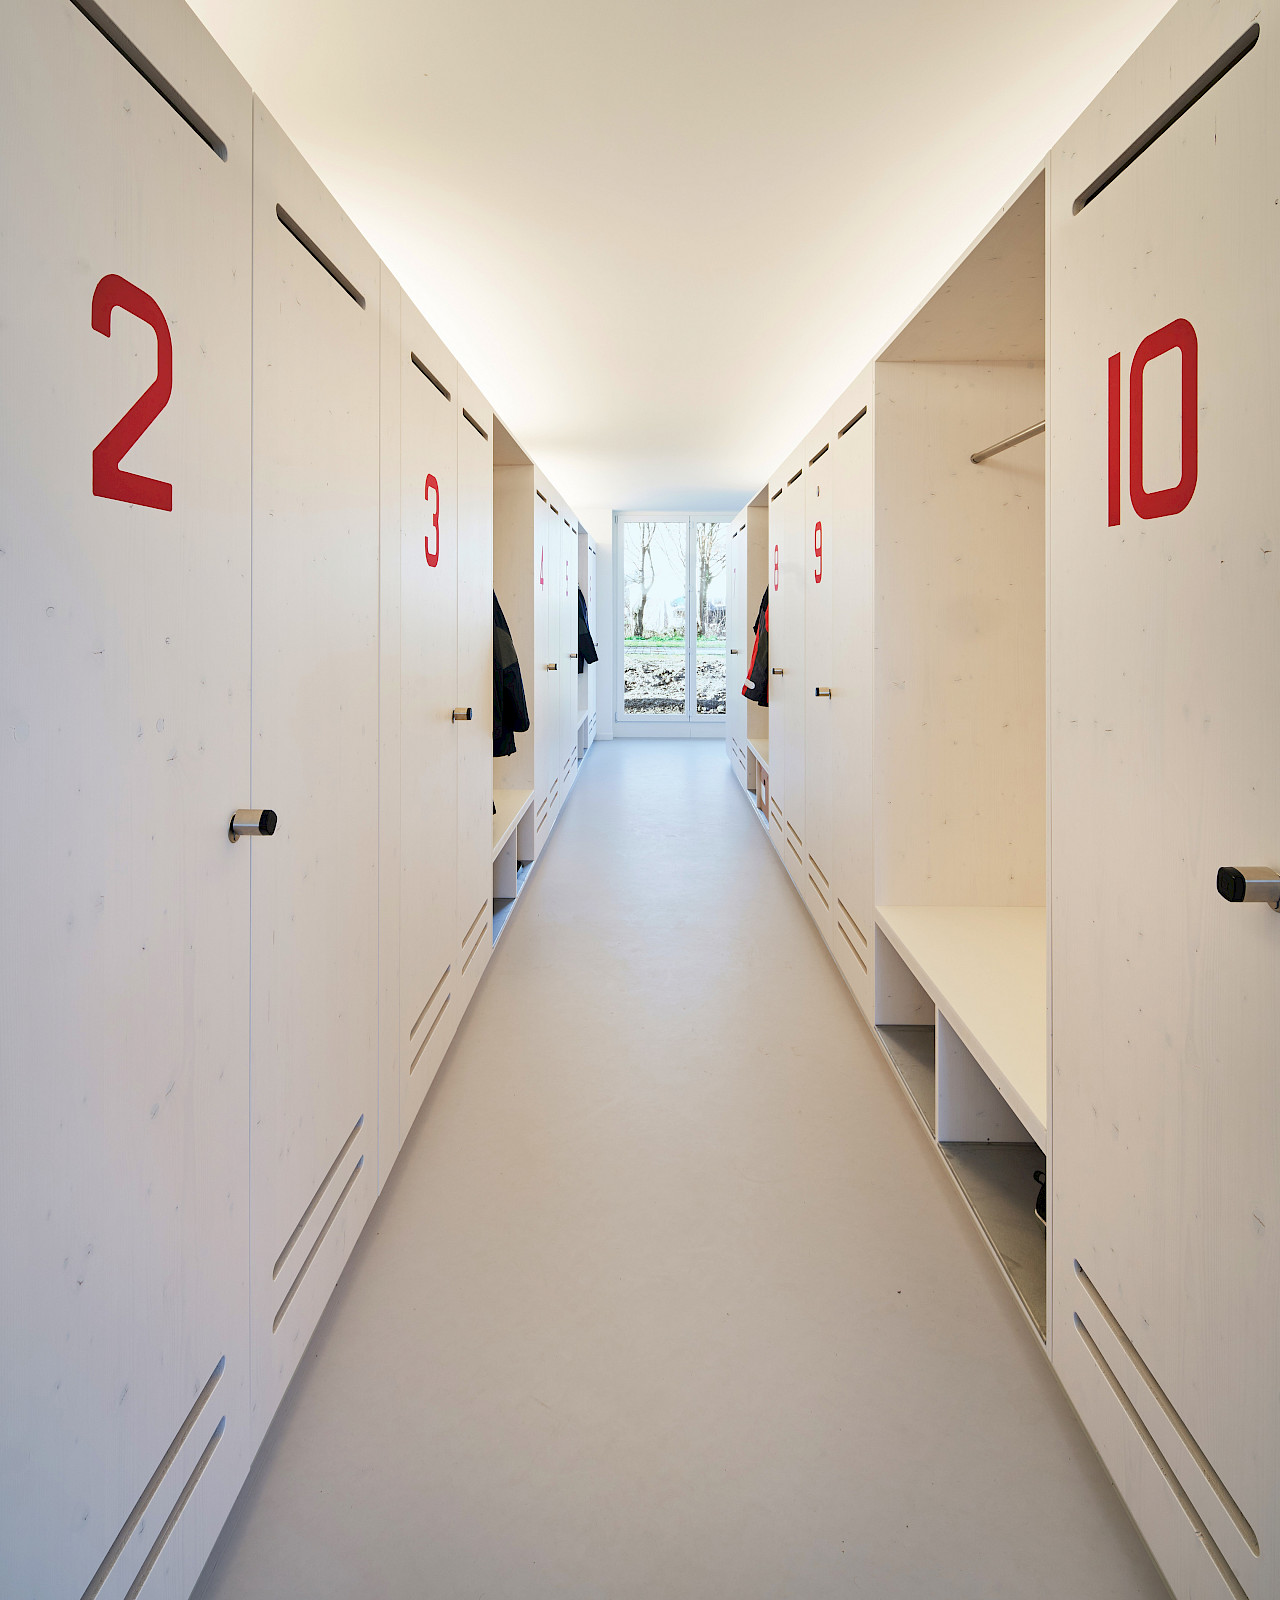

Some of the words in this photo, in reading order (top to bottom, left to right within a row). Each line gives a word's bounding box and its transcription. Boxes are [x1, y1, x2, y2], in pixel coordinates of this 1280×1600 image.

[91, 273, 173, 512] 2
[1108, 318, 1198, 528] 10
[424, 473, 439, 568] 3
[814, 521, 823, 584] 9
[540, 545, 544, 591] 4
[774, 545, 779, 591] 8
